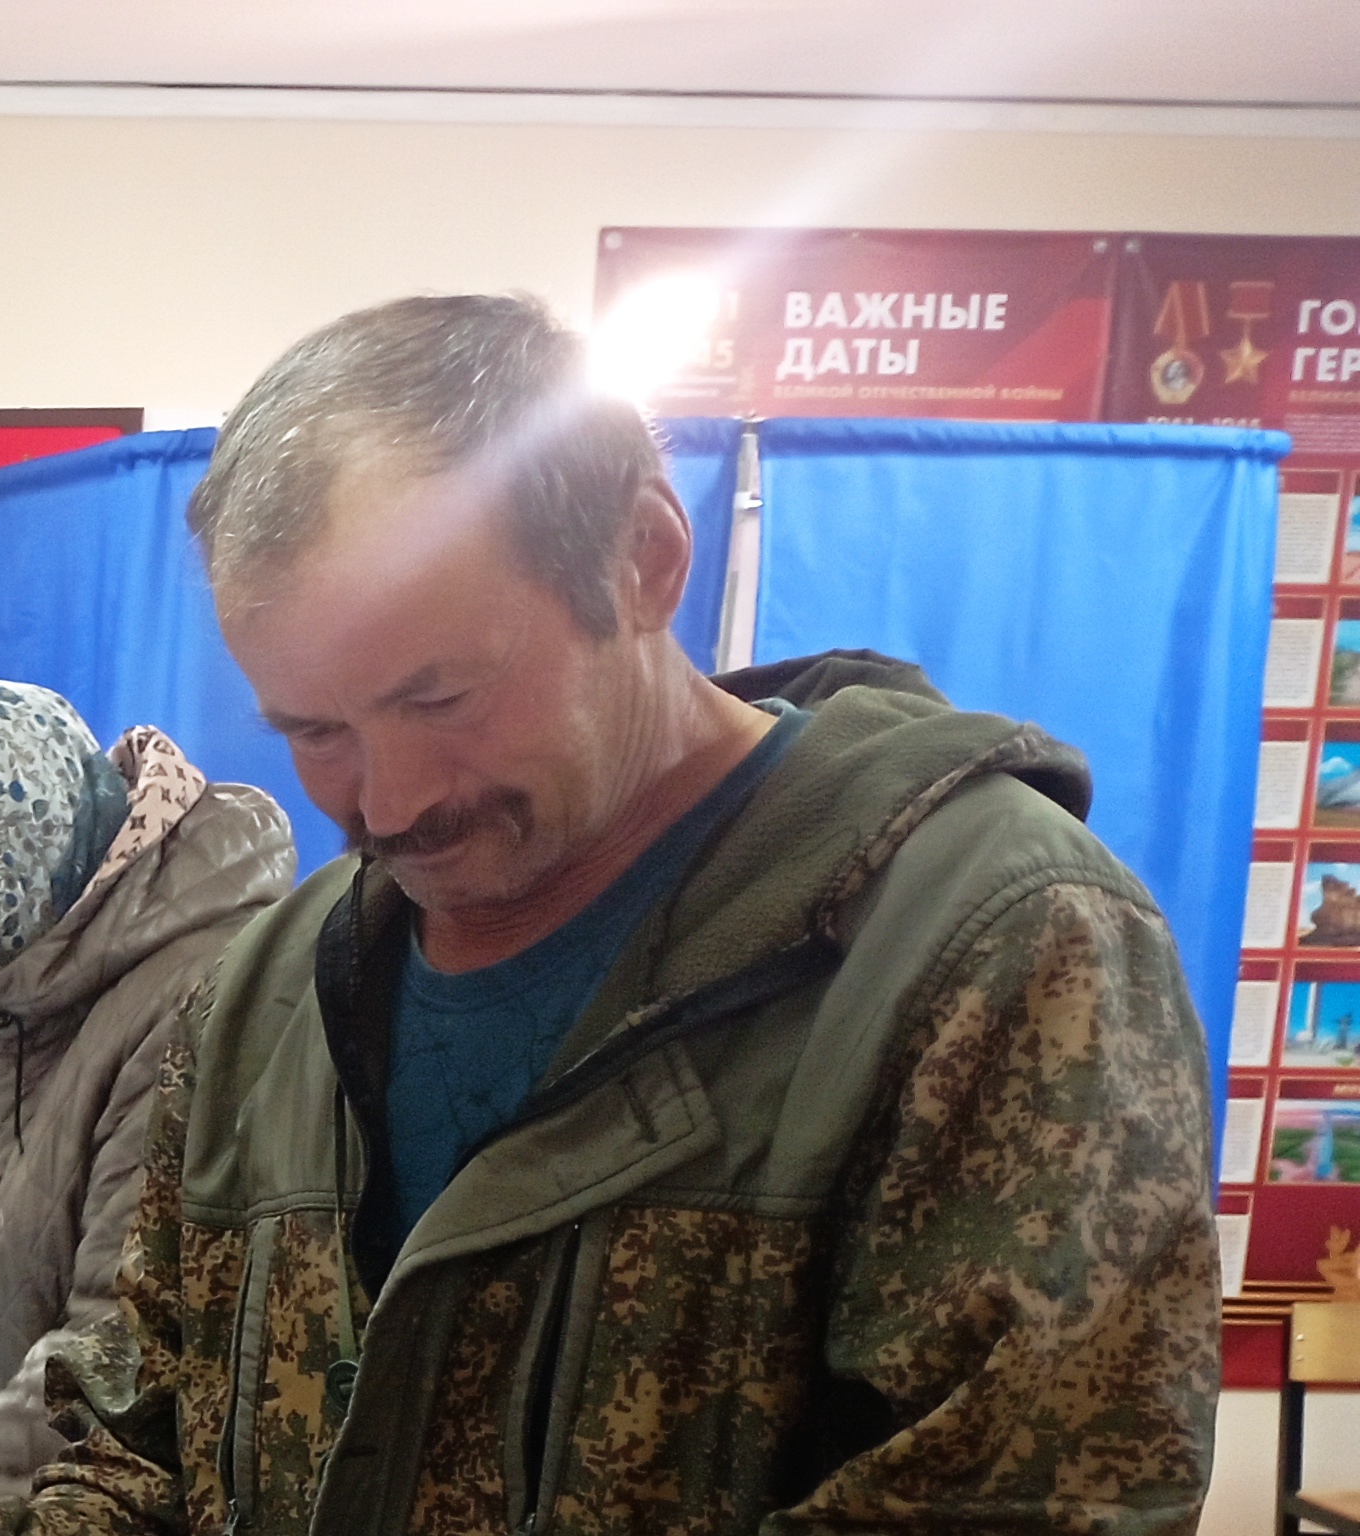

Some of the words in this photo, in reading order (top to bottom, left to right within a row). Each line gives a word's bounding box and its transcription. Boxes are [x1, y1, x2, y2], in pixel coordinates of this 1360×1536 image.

[783, 292, 1009, 330] ВАЖНЫЕ
[1297, 298, 1360, 336] ГО
[776, 338, 920, 381] ДАТЫ
